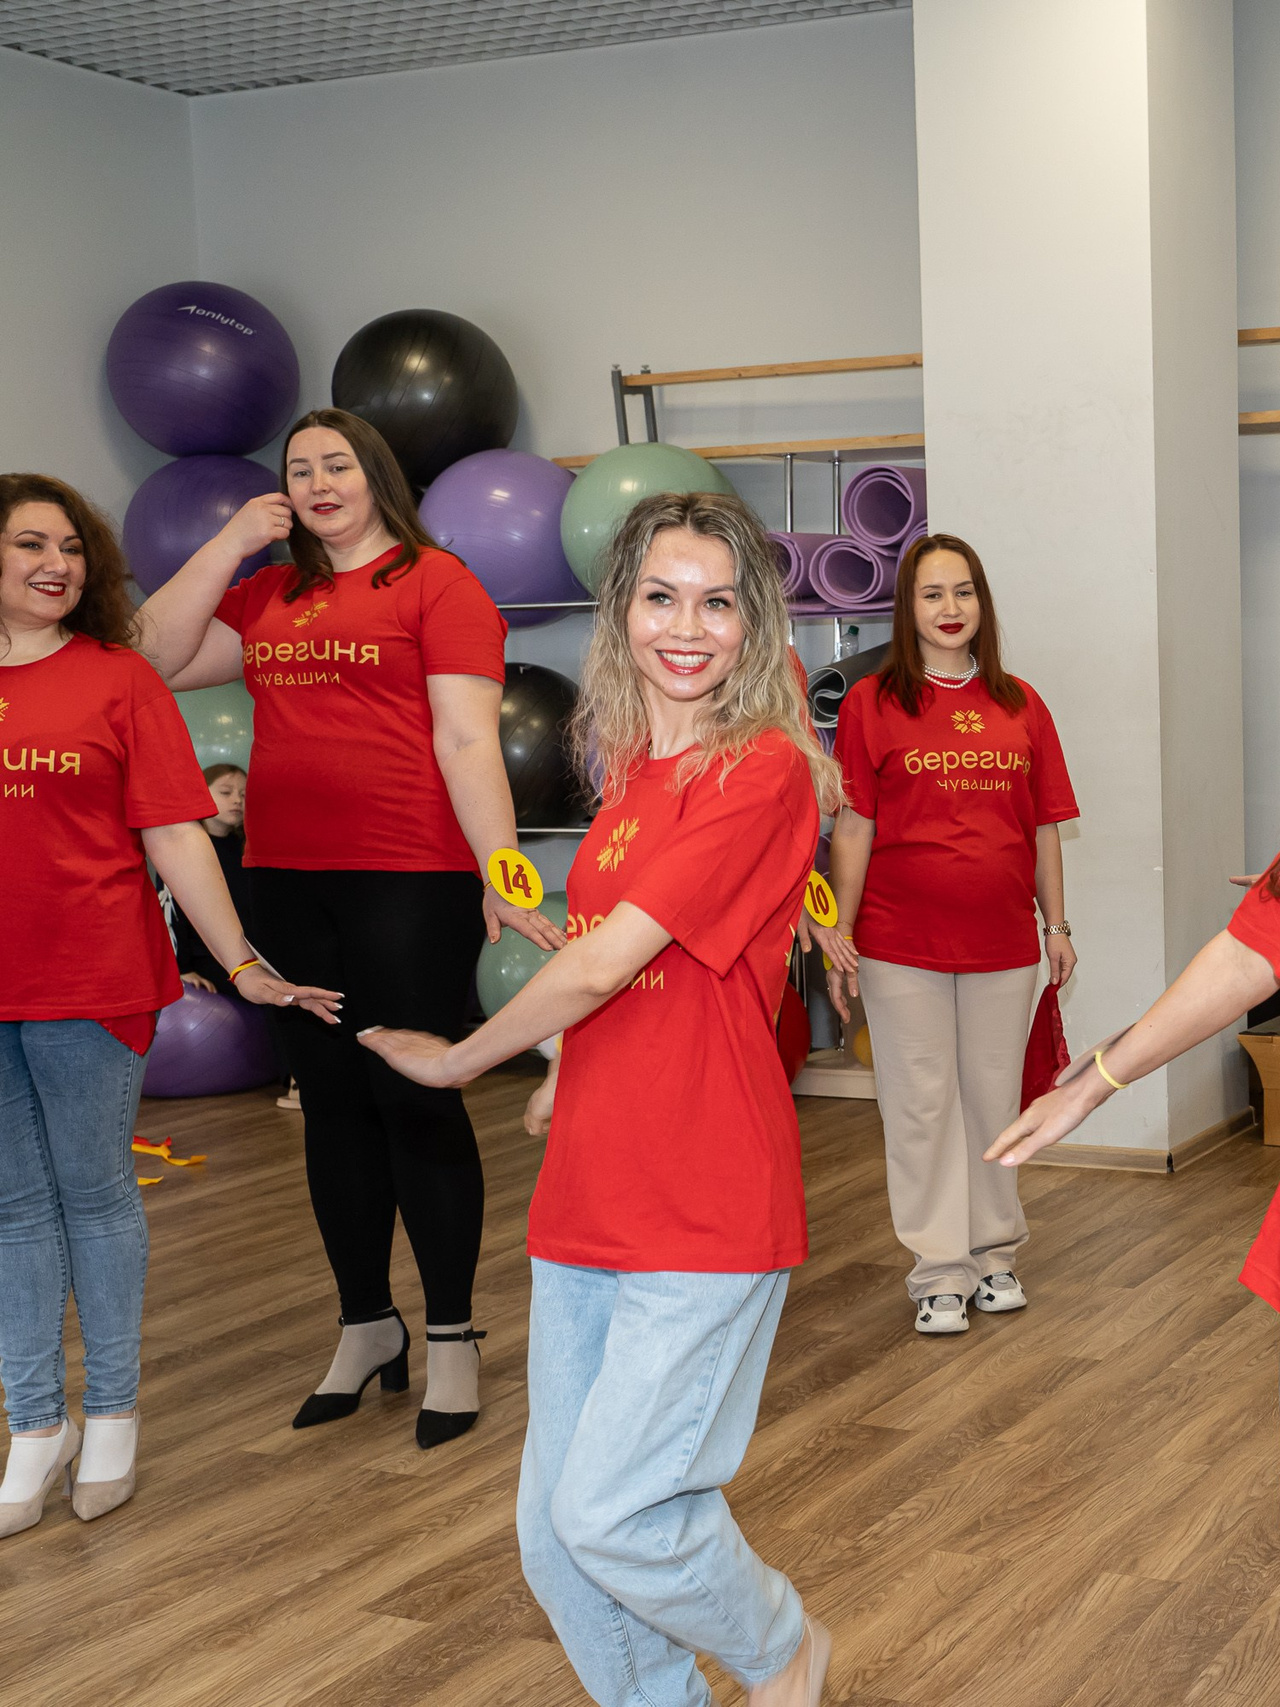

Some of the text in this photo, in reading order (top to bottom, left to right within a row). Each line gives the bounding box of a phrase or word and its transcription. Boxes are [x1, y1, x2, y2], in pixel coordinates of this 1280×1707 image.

[243, 640, 380, 668] ерегиня
[253, 671, 340, 687] чувашии
[499, 860, 533, 899] 14
[806, 881, 829, 915] 10
